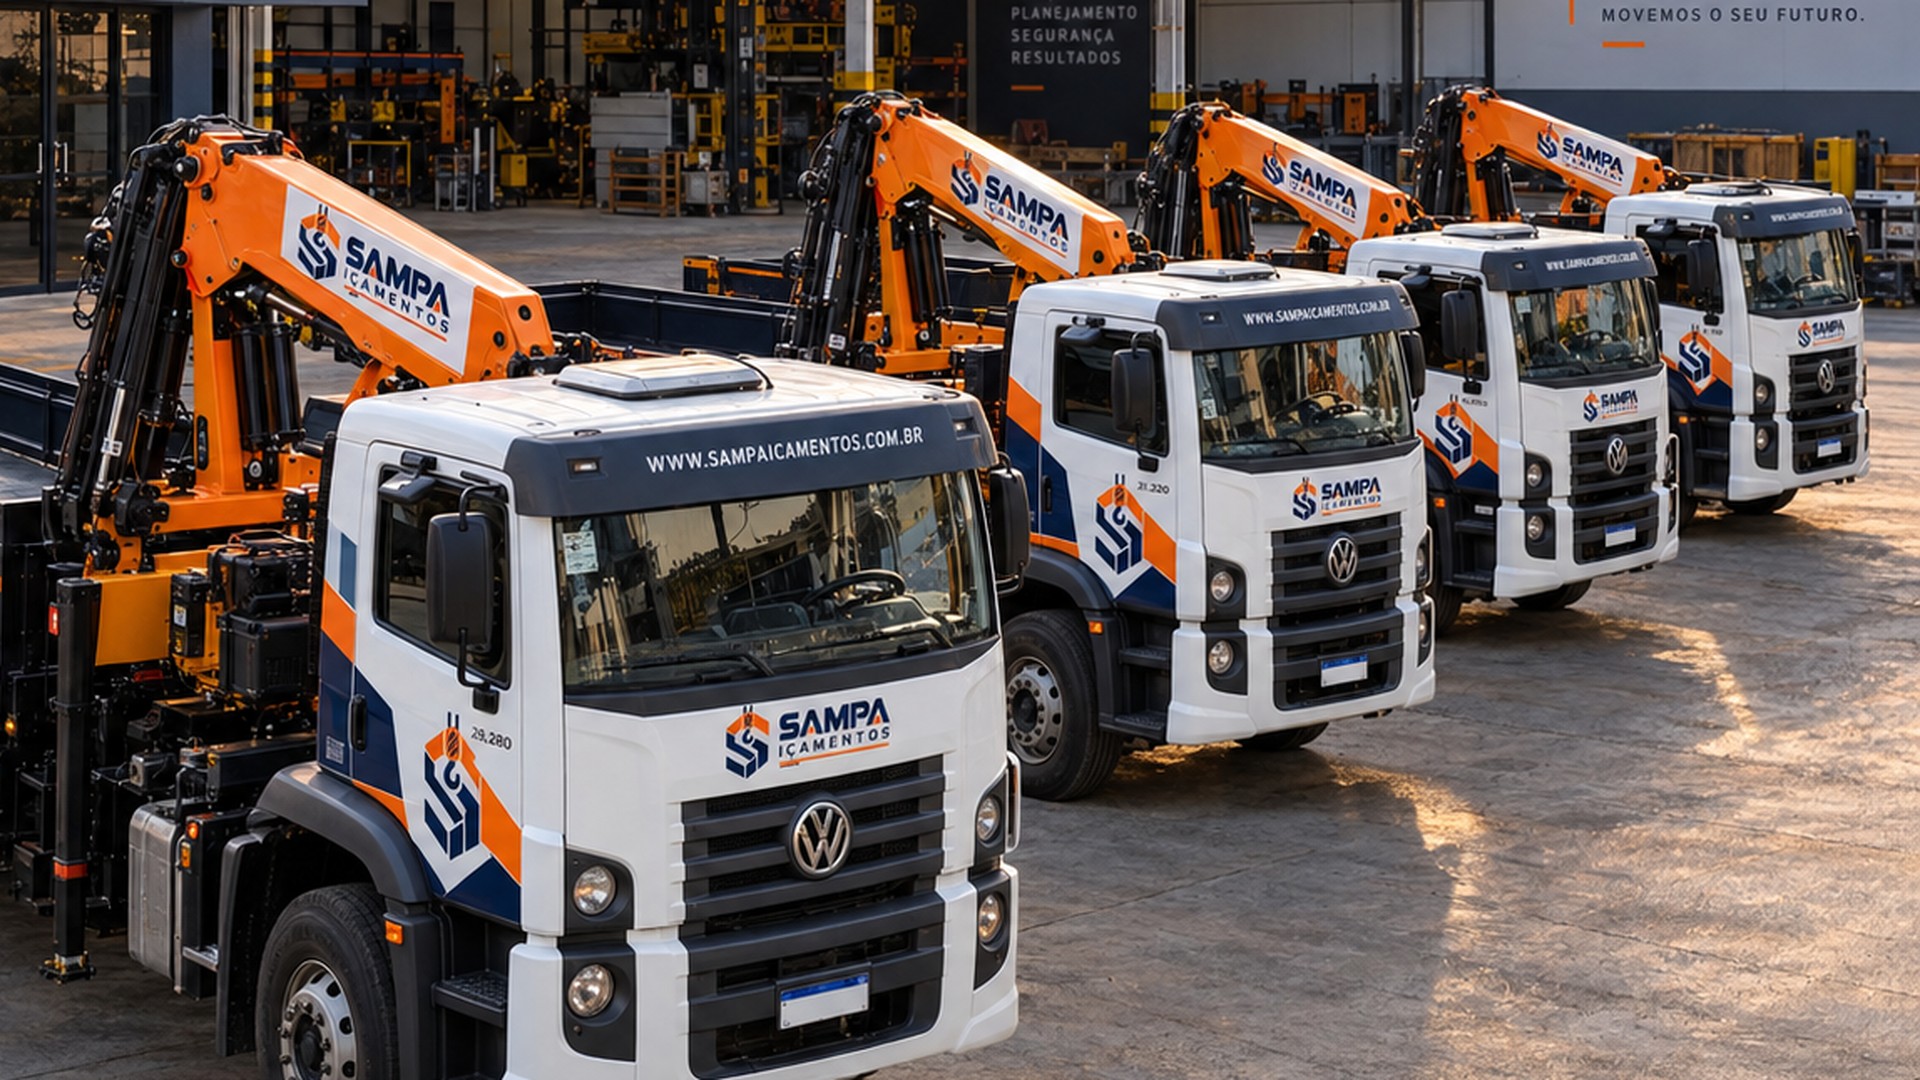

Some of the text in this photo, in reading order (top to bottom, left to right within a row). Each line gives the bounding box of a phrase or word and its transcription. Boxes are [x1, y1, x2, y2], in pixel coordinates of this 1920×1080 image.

[1011, 5, 1137, 21] PLANEJAMENTO
[1601, 7, 1866, 22] MOVEMOS O SEU FUTURO.
[1011, 28, 1114, 45] SEGURANÇA
[1011, 50, 1121, 64] RESULTADOS
[1562, 136, 1623, 175] SAMPA
[1289, 160, 1357, 210] SAMPA
[984, 175, 1069, 241] SAMPA
[345, 236, 450, 318] SAMPA
[646, 425, 924, 473] WWW.SAMPAICAMENTOS.COM.BR
[1321, 476, 1381, 500] SAMPA
[779, 697, 890, 741] SAMPA
[779, 726, 890, 760] IÇAMENTOS
